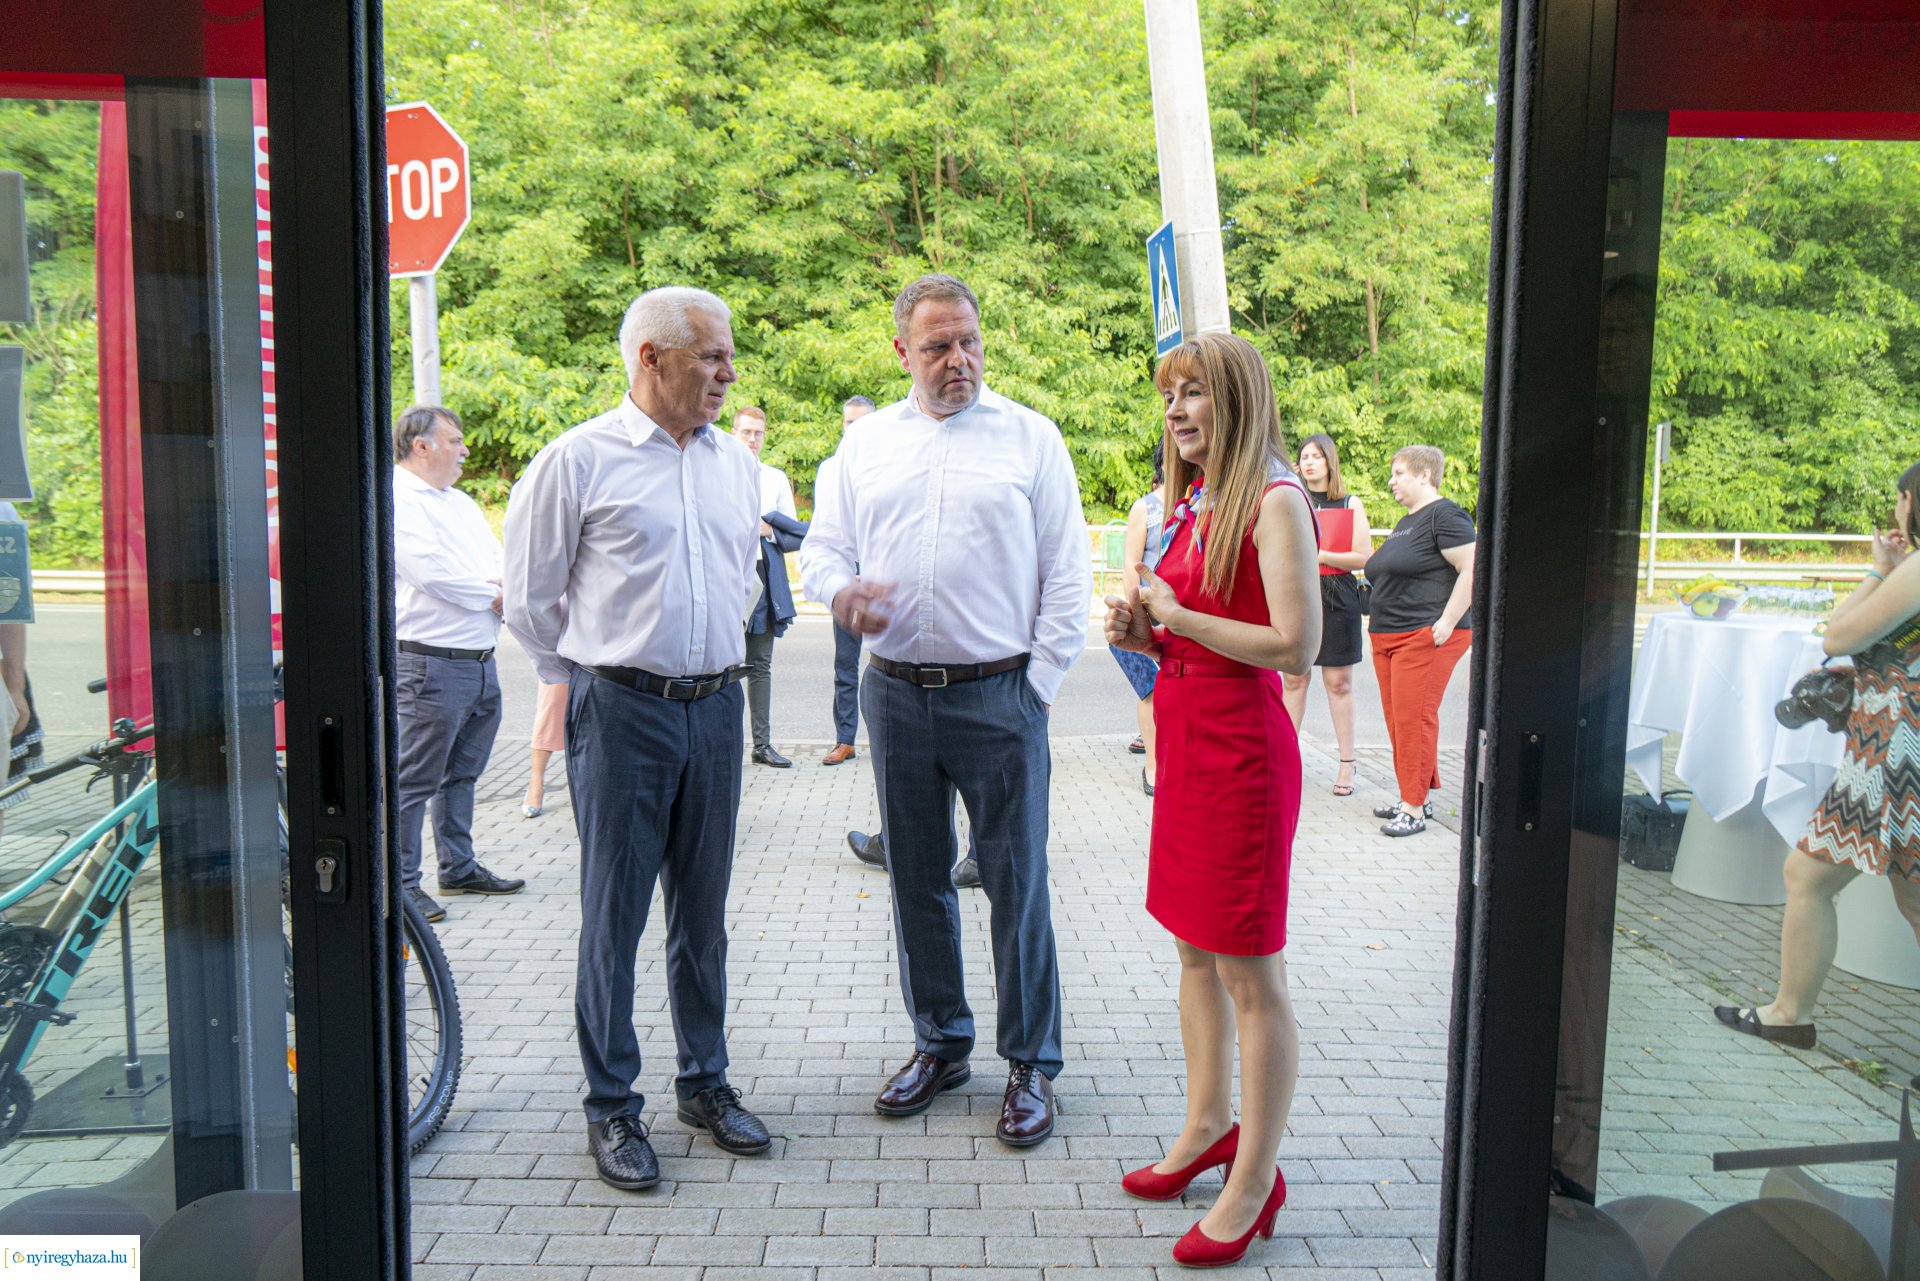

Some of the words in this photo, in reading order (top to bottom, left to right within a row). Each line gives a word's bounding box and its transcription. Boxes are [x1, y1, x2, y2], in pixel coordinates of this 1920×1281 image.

[386, 157, 460, 223] TOP
[30, 808, 158, 1022] TREK
[424, 1106, 441, 1125] XR2
[439, 1070, 454, 1104] COMP
